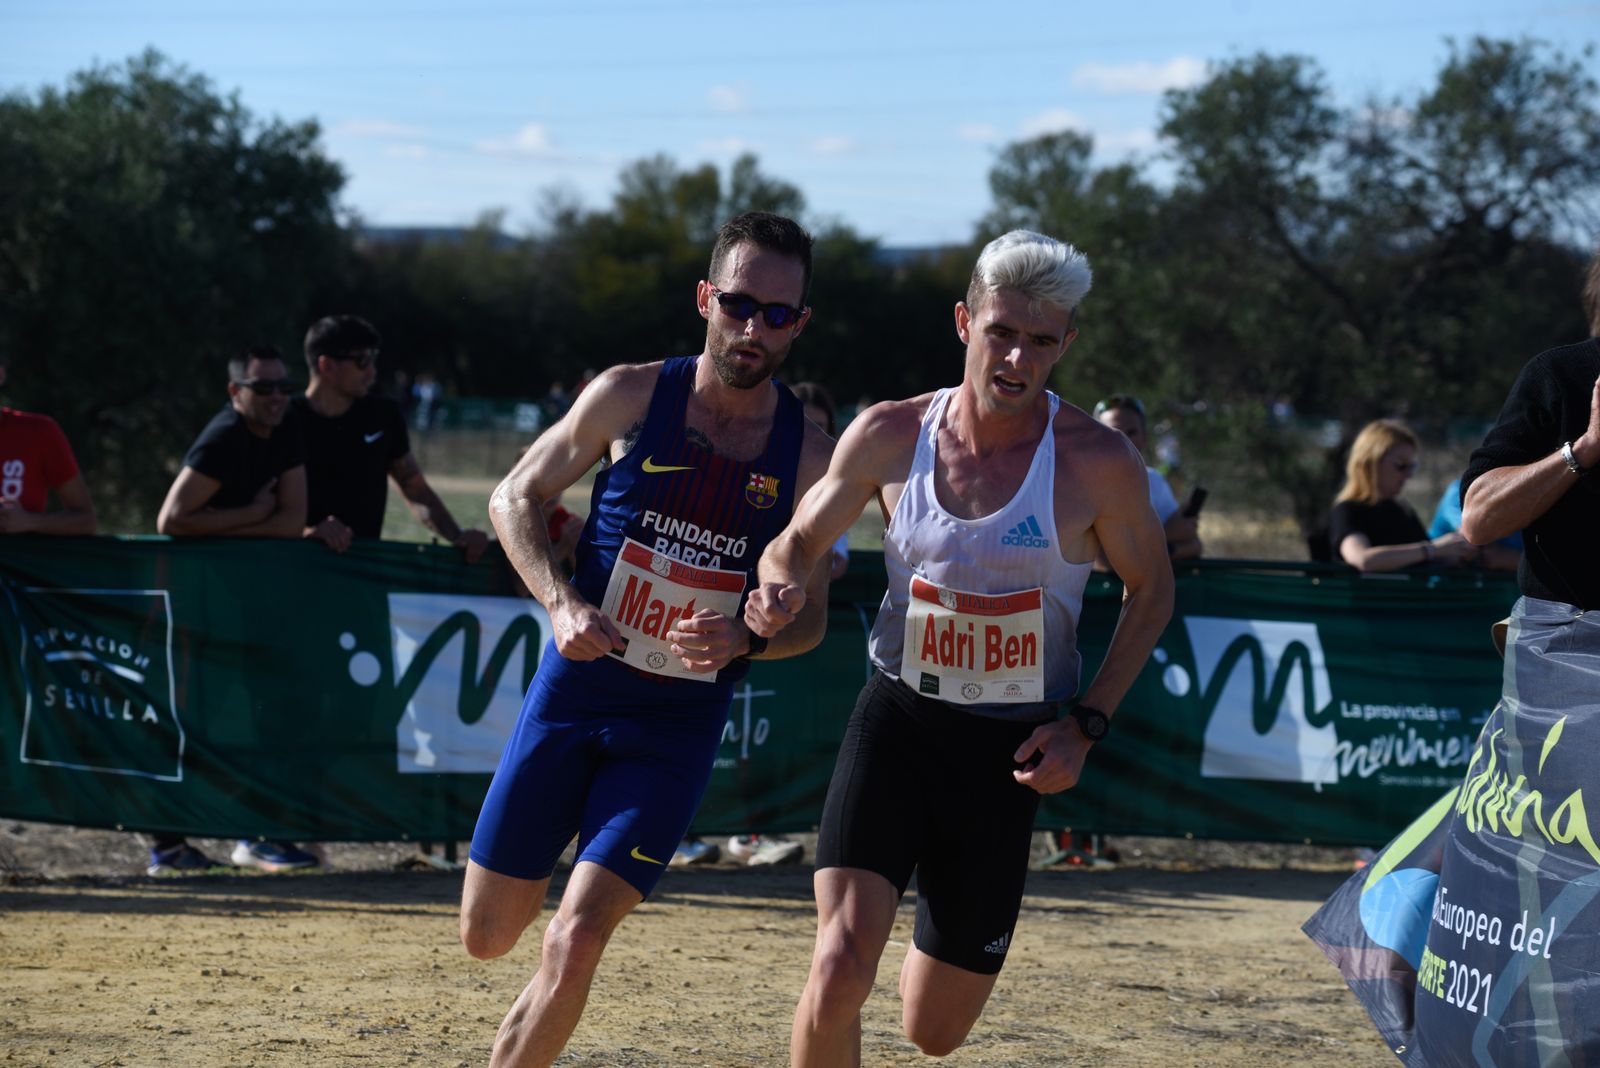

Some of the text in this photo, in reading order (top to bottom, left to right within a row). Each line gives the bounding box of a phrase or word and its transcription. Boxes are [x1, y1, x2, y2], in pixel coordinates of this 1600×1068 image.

[2, 459, 25, 500] as
[641, 509, 748, 558] FUNDACIÓ
[1001, 534, 1049, 549] adidas
[616, 574, 696, 641] Mart
[920, 612, 1037, 673] Adri Ben
[1340, 700, 1363, 719] La
[1363, 703, 1439, 722] provincia
[1438, 886, 1503, 951] Europea
[1510, 909, 1556, 960] del
[1446, 959, 1493, 1017] 2021
